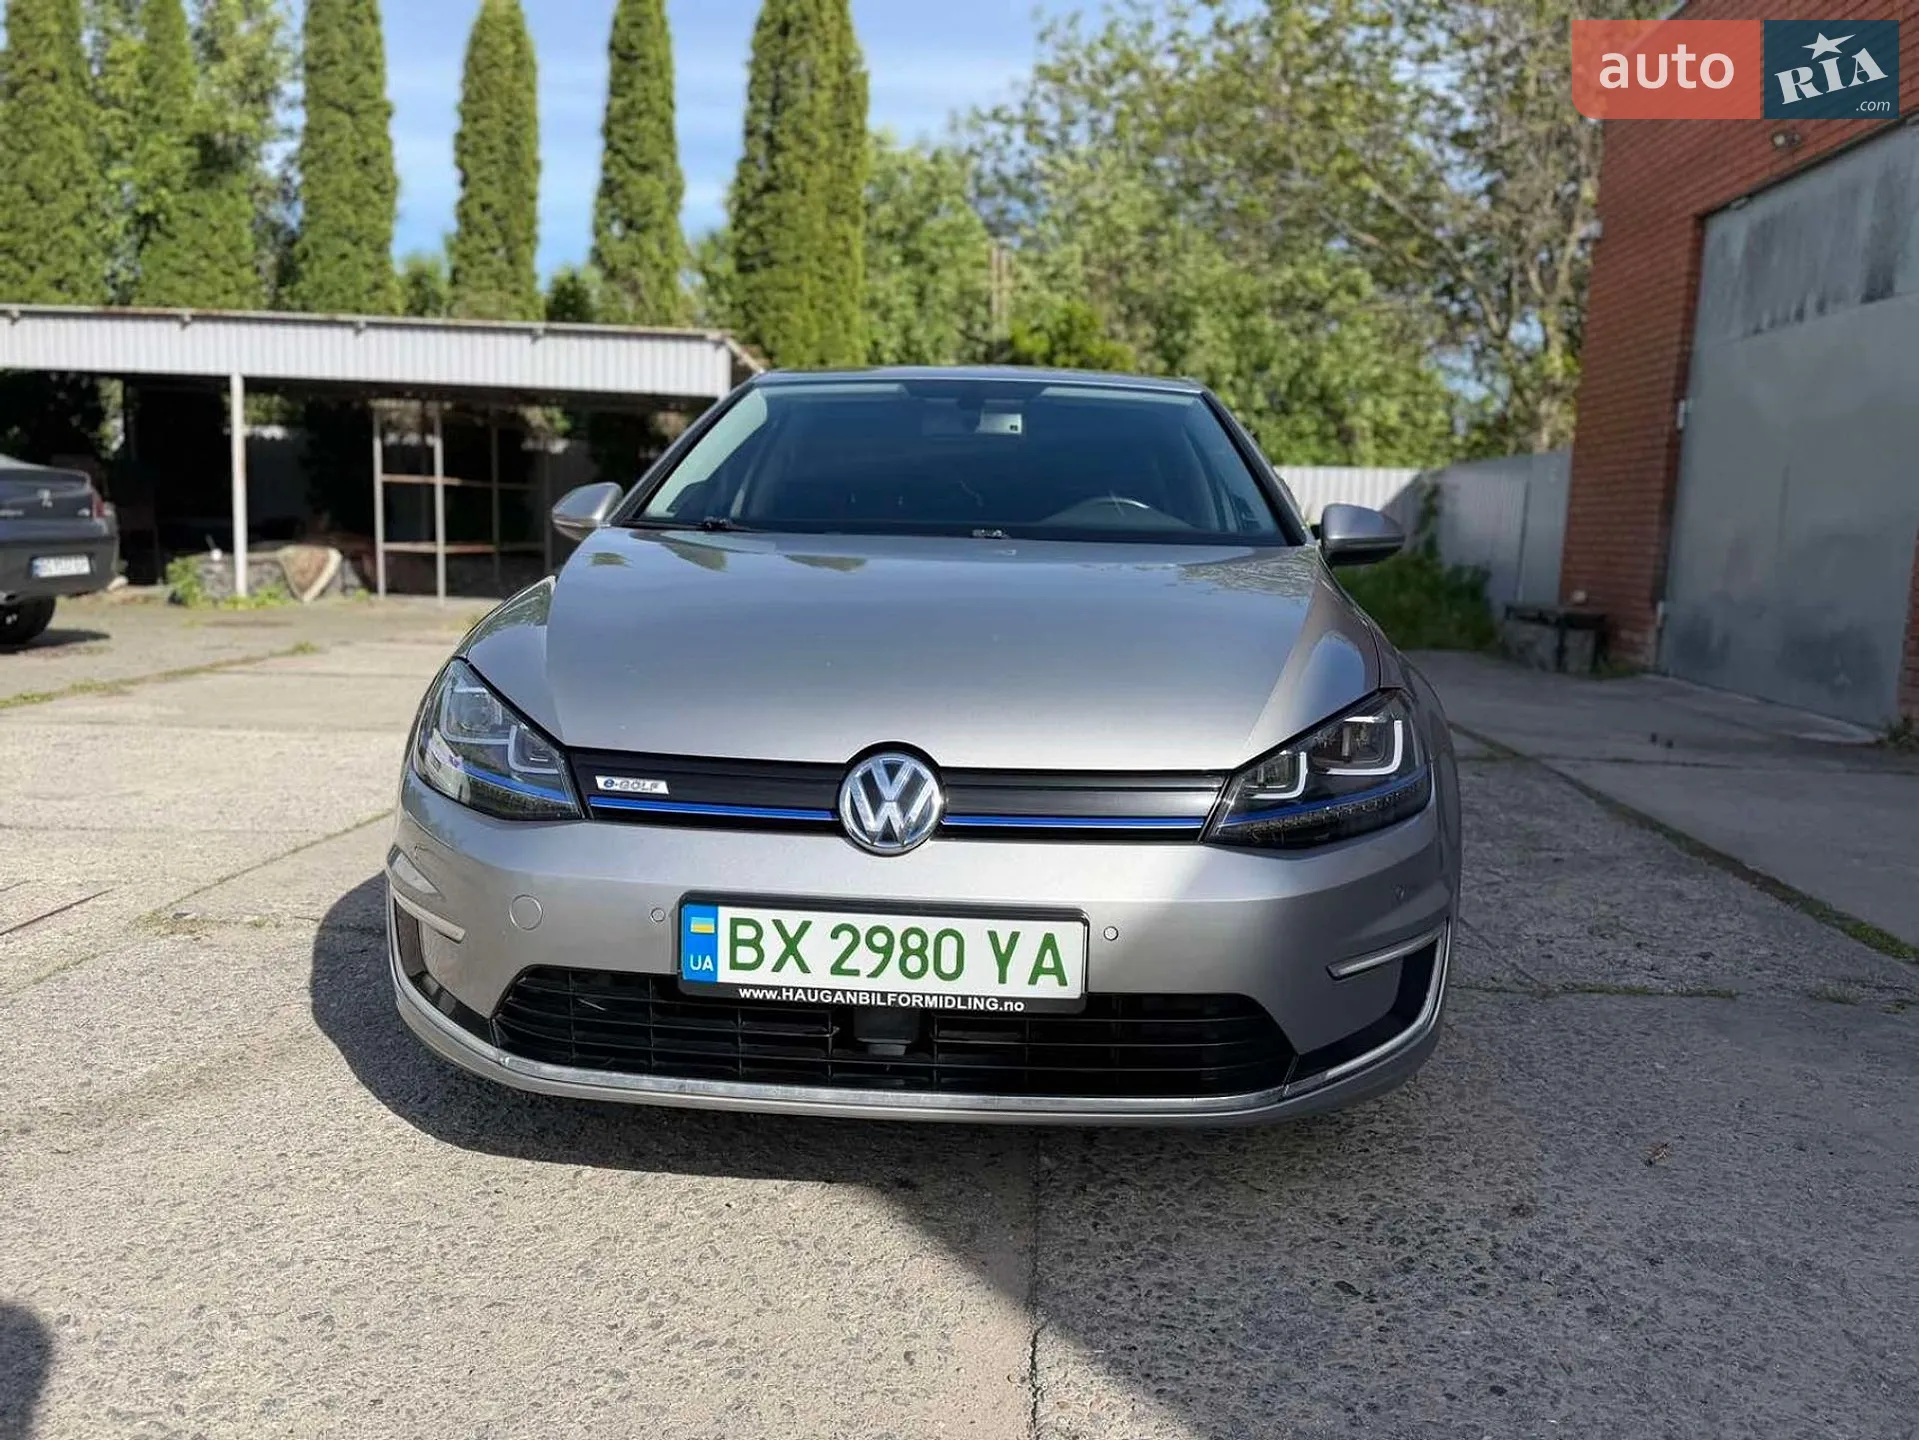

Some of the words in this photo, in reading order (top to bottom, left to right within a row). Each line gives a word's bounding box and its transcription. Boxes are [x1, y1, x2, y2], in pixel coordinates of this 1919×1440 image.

[849, 754, 937, 847] VW
[689, 955, 714, 972] UA
[729, 917, 812, 973] BX
[830, 923, 964, 982] 2980
[988, 930, 1068, 986] YA
[738, 987, 1025, 1012] www.HAUGANBILFORMIDLING.no
